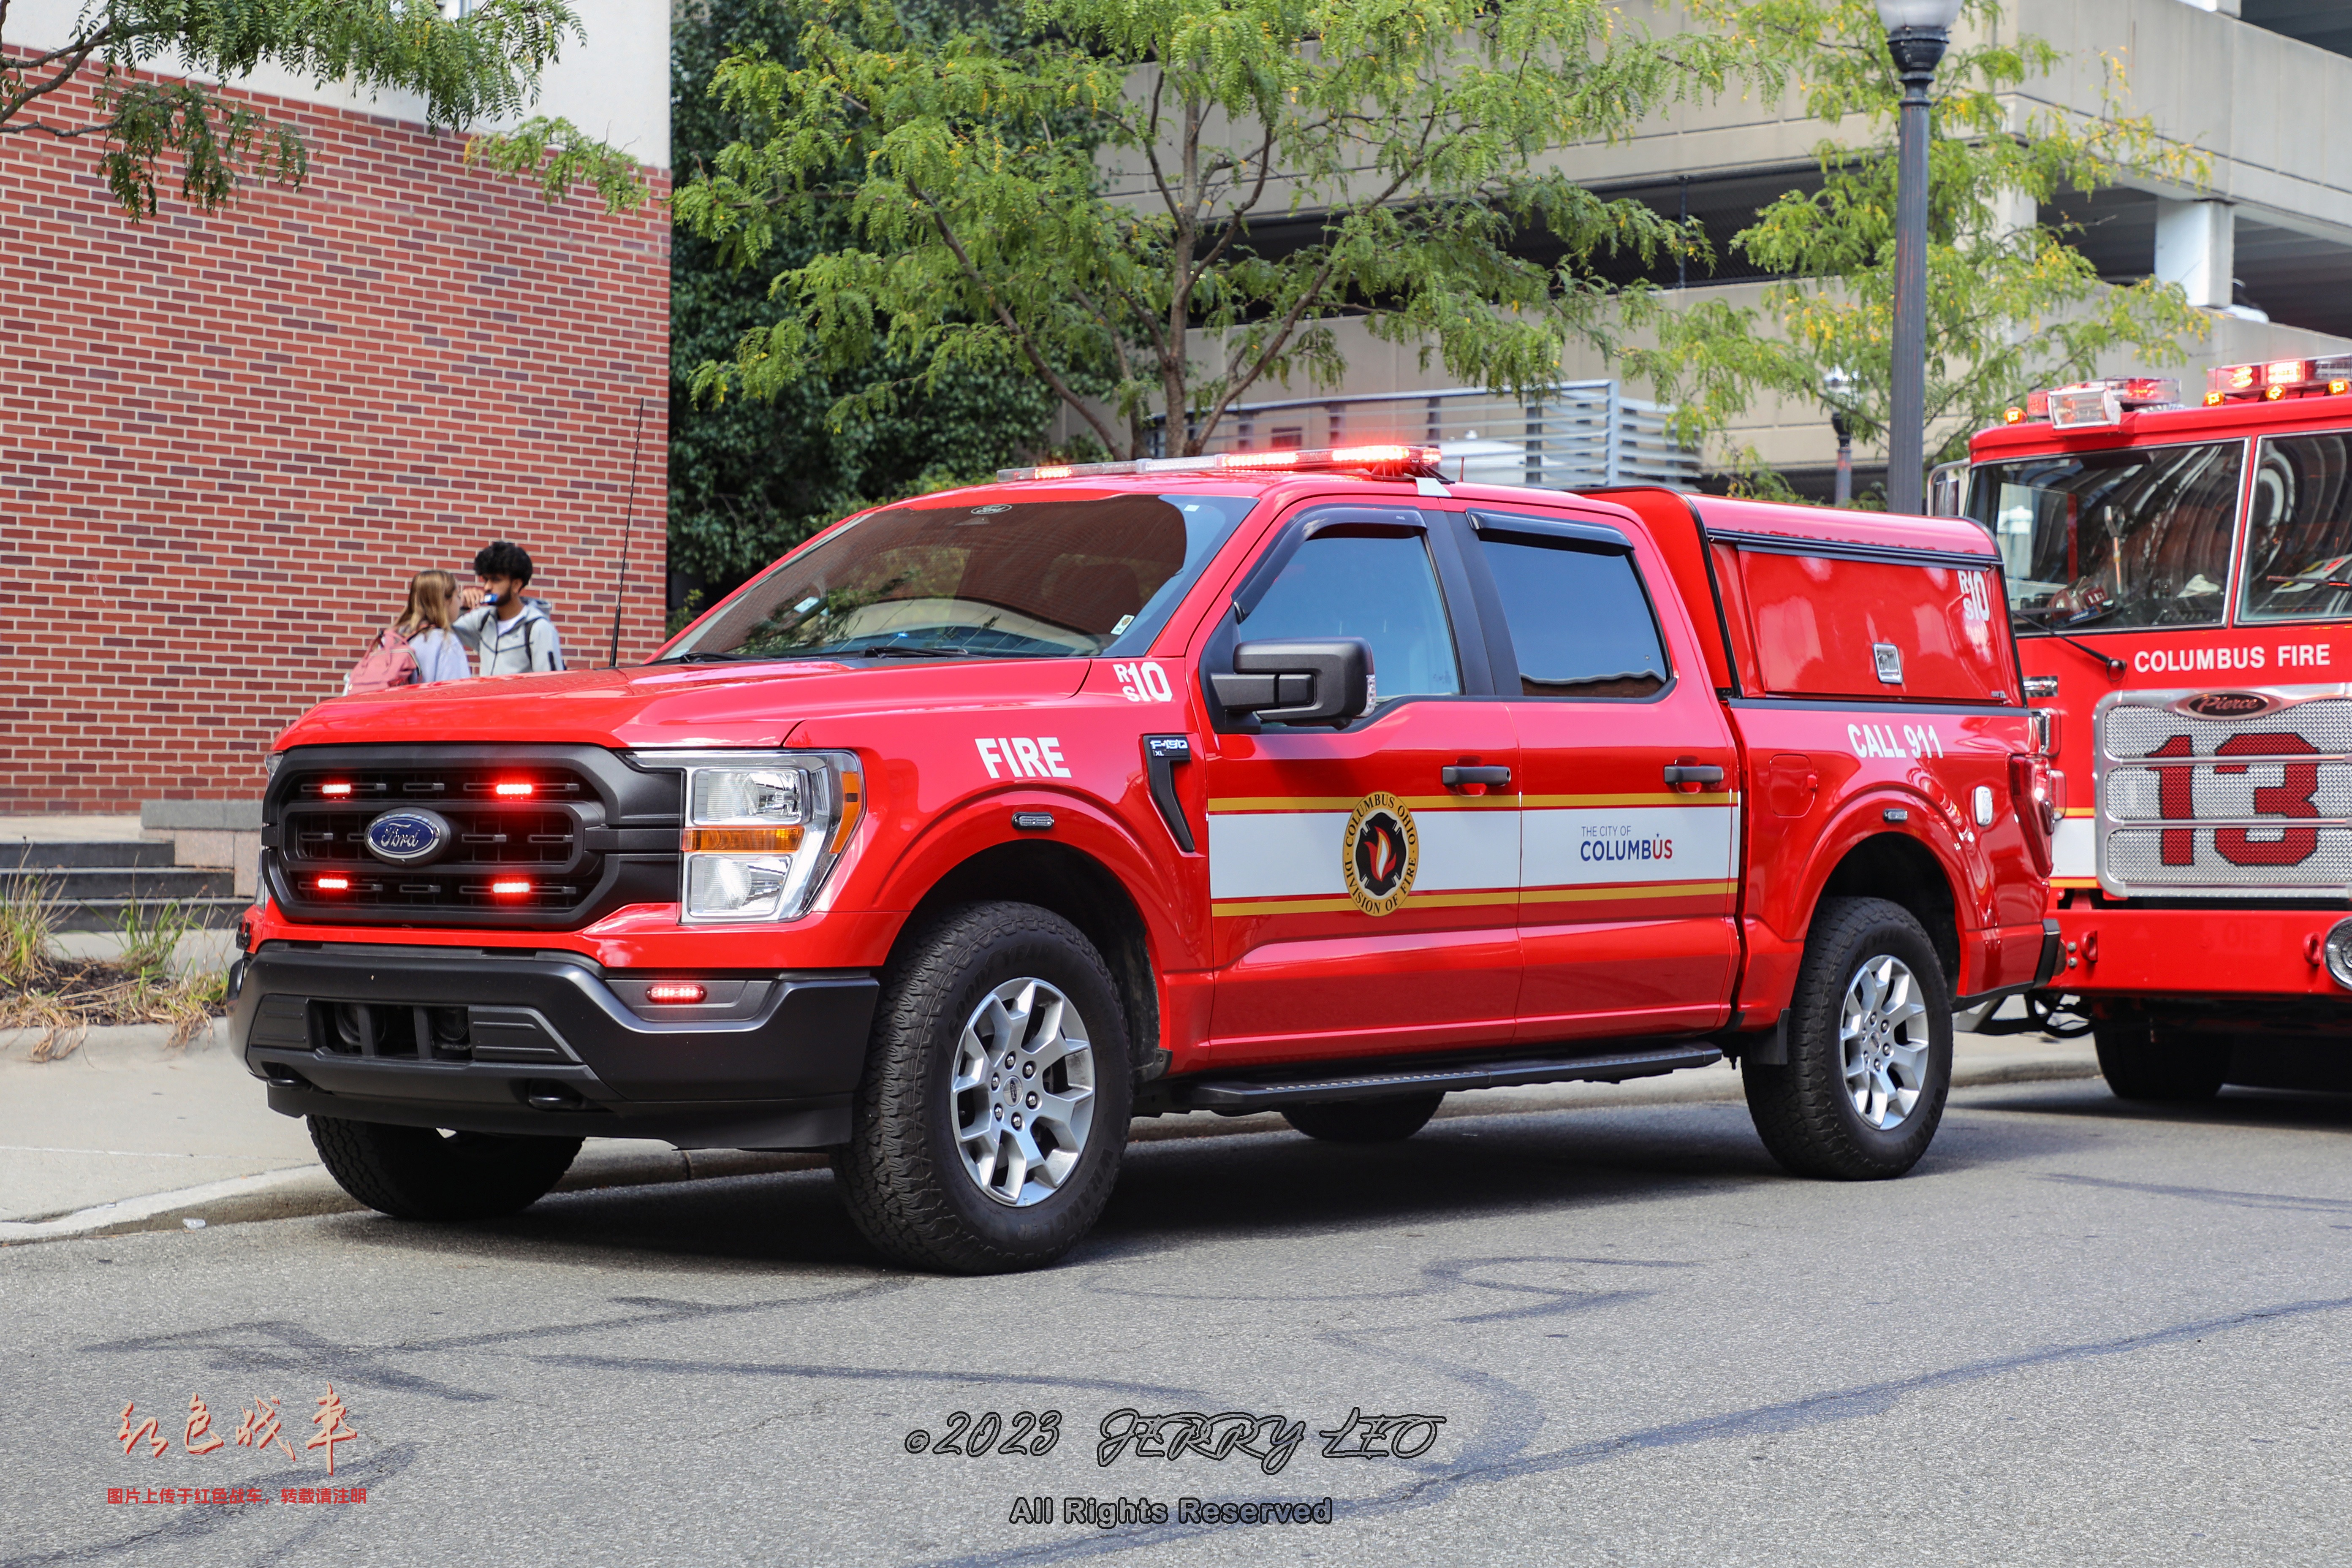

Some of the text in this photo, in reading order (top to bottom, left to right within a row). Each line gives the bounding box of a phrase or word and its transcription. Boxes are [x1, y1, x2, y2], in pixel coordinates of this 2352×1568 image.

[2134, 644, 2331, 673] COLUMBUS FIRE
[1127, 661, 1173, 702] 10
[2197, 696, 2259, 713] Pierce
[1150, 739, 1188, 749] F-150
[1847, 724, 1943, 759] CALL 911
[974, 737, 1072, 779] FIRE
[2146, 732, 2321, 866] 13
[380, 823, 421, 848] Ford
[1345, 793, 1416, 848] COLUMBUS OHIO
[1581, 825, 1631, 837] THE CITY OF
[1581, 838, 1673, 861] COLUMBUS
[1344, 857, 1416, 914] DIVISION OF FIRE
